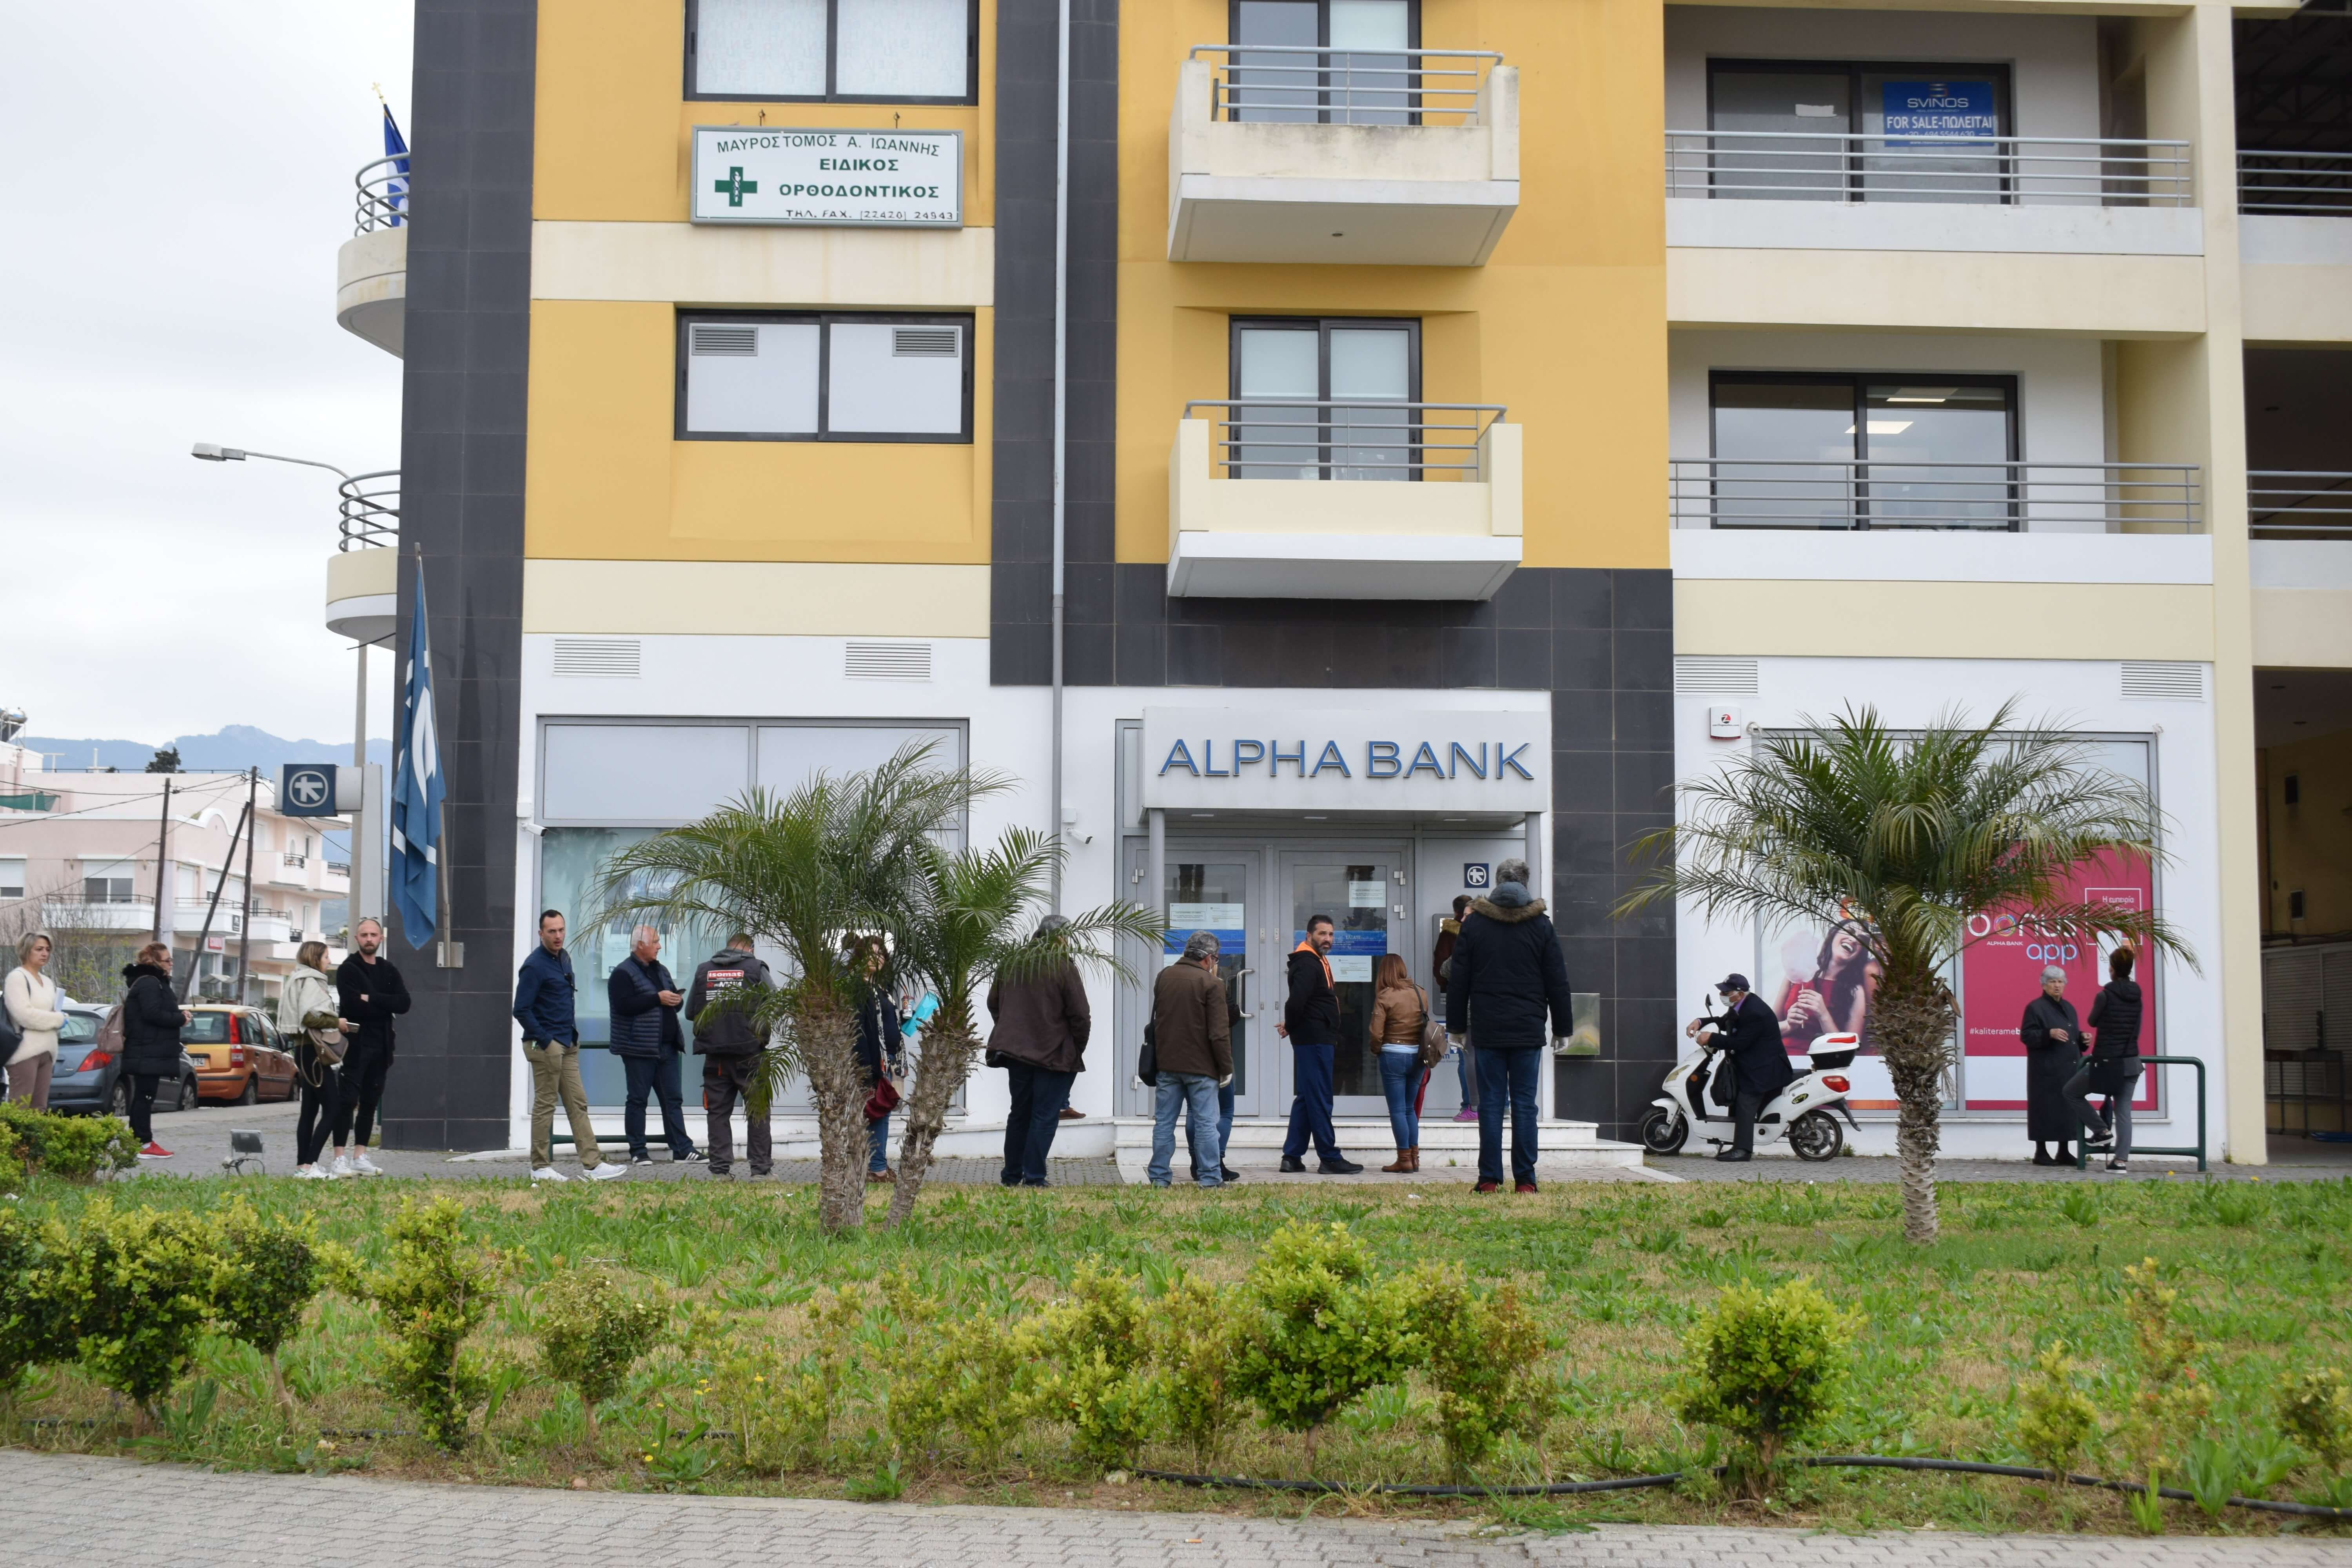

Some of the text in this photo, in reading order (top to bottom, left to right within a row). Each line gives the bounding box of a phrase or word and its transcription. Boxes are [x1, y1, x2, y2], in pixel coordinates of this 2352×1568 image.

[1907, 98, 1969, 108] SVINOS
[1887, 116, 1909, 129] FOR
[847, 136, 861, 148] Α.
[872, 137, 940, 156] ΙΩΑΝΝΗΣ
[820, 159, 898, 171] ΕΙΔΙΚΟΣ
[779, 184, 939, 198] ΟΡΘΟΔΟΝΤΙΚΟΣ
[1158, 739, 1534, 780] ALPHA BANK
[2026, 944, 2077, 965] app
